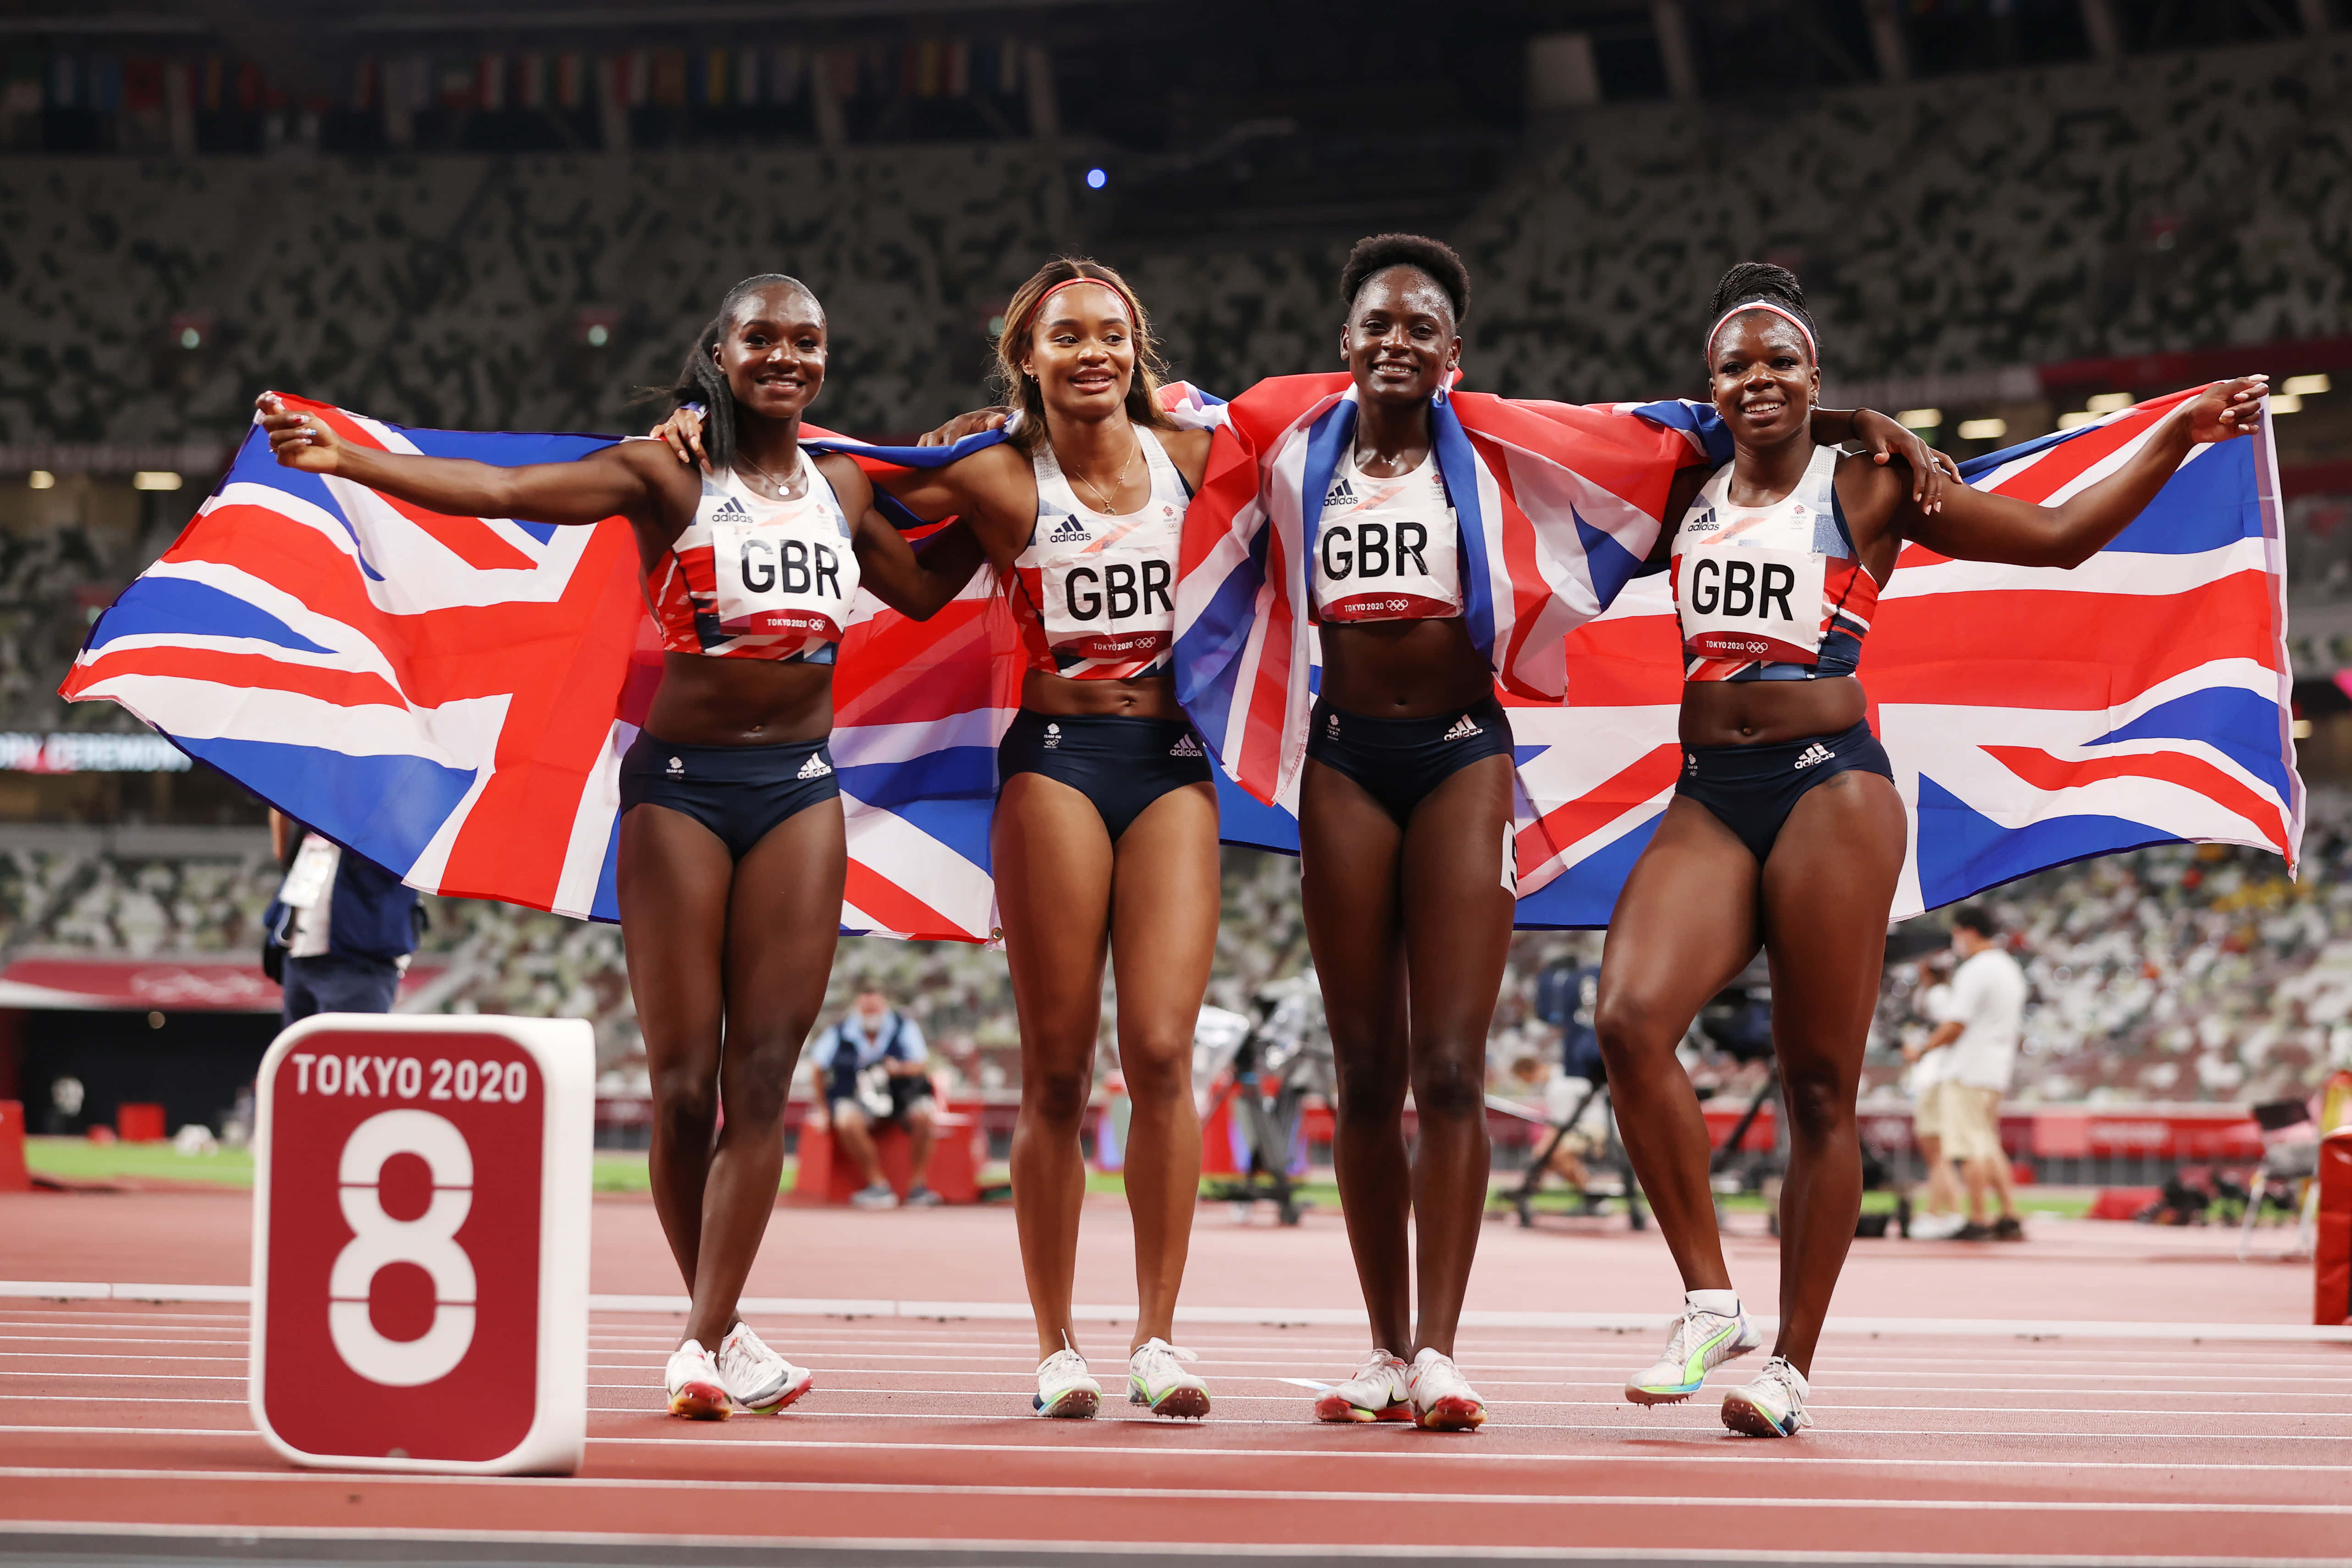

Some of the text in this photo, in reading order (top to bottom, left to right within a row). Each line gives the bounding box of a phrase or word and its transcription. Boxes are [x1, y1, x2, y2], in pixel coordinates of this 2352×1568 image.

[1324, 495, 1358, 506] adidas
[712, 512, 753, 523] adidas
[1688, 523, 1719, 532] adidas
[1050, 531, 1091, 543] adidas
[1322, 522, 1430, 581] GBR
[741, 539, 842, 600] GBR
[1065, 559, 1174, 621] GBR
[1692, 558, 1795, 621] GBR
[1344, 602, 1384, 612] TOKYO 2020
[791, 619, 807, 627] 2020
[1093, 641, 1133, 651] TOKYO 2020
[1706, 640, 1727, 649] TOKYO
[1444, 727, 1483, 741] adidas
[1169, 748, 1202, 757] adidas
[1795, 751, 1835, 769] adidas
[797, 765, 832, 780] adidas
[292, 1053, 528, 1103] TOKYO 2020
[328, 1107, 477, 1387] 8
